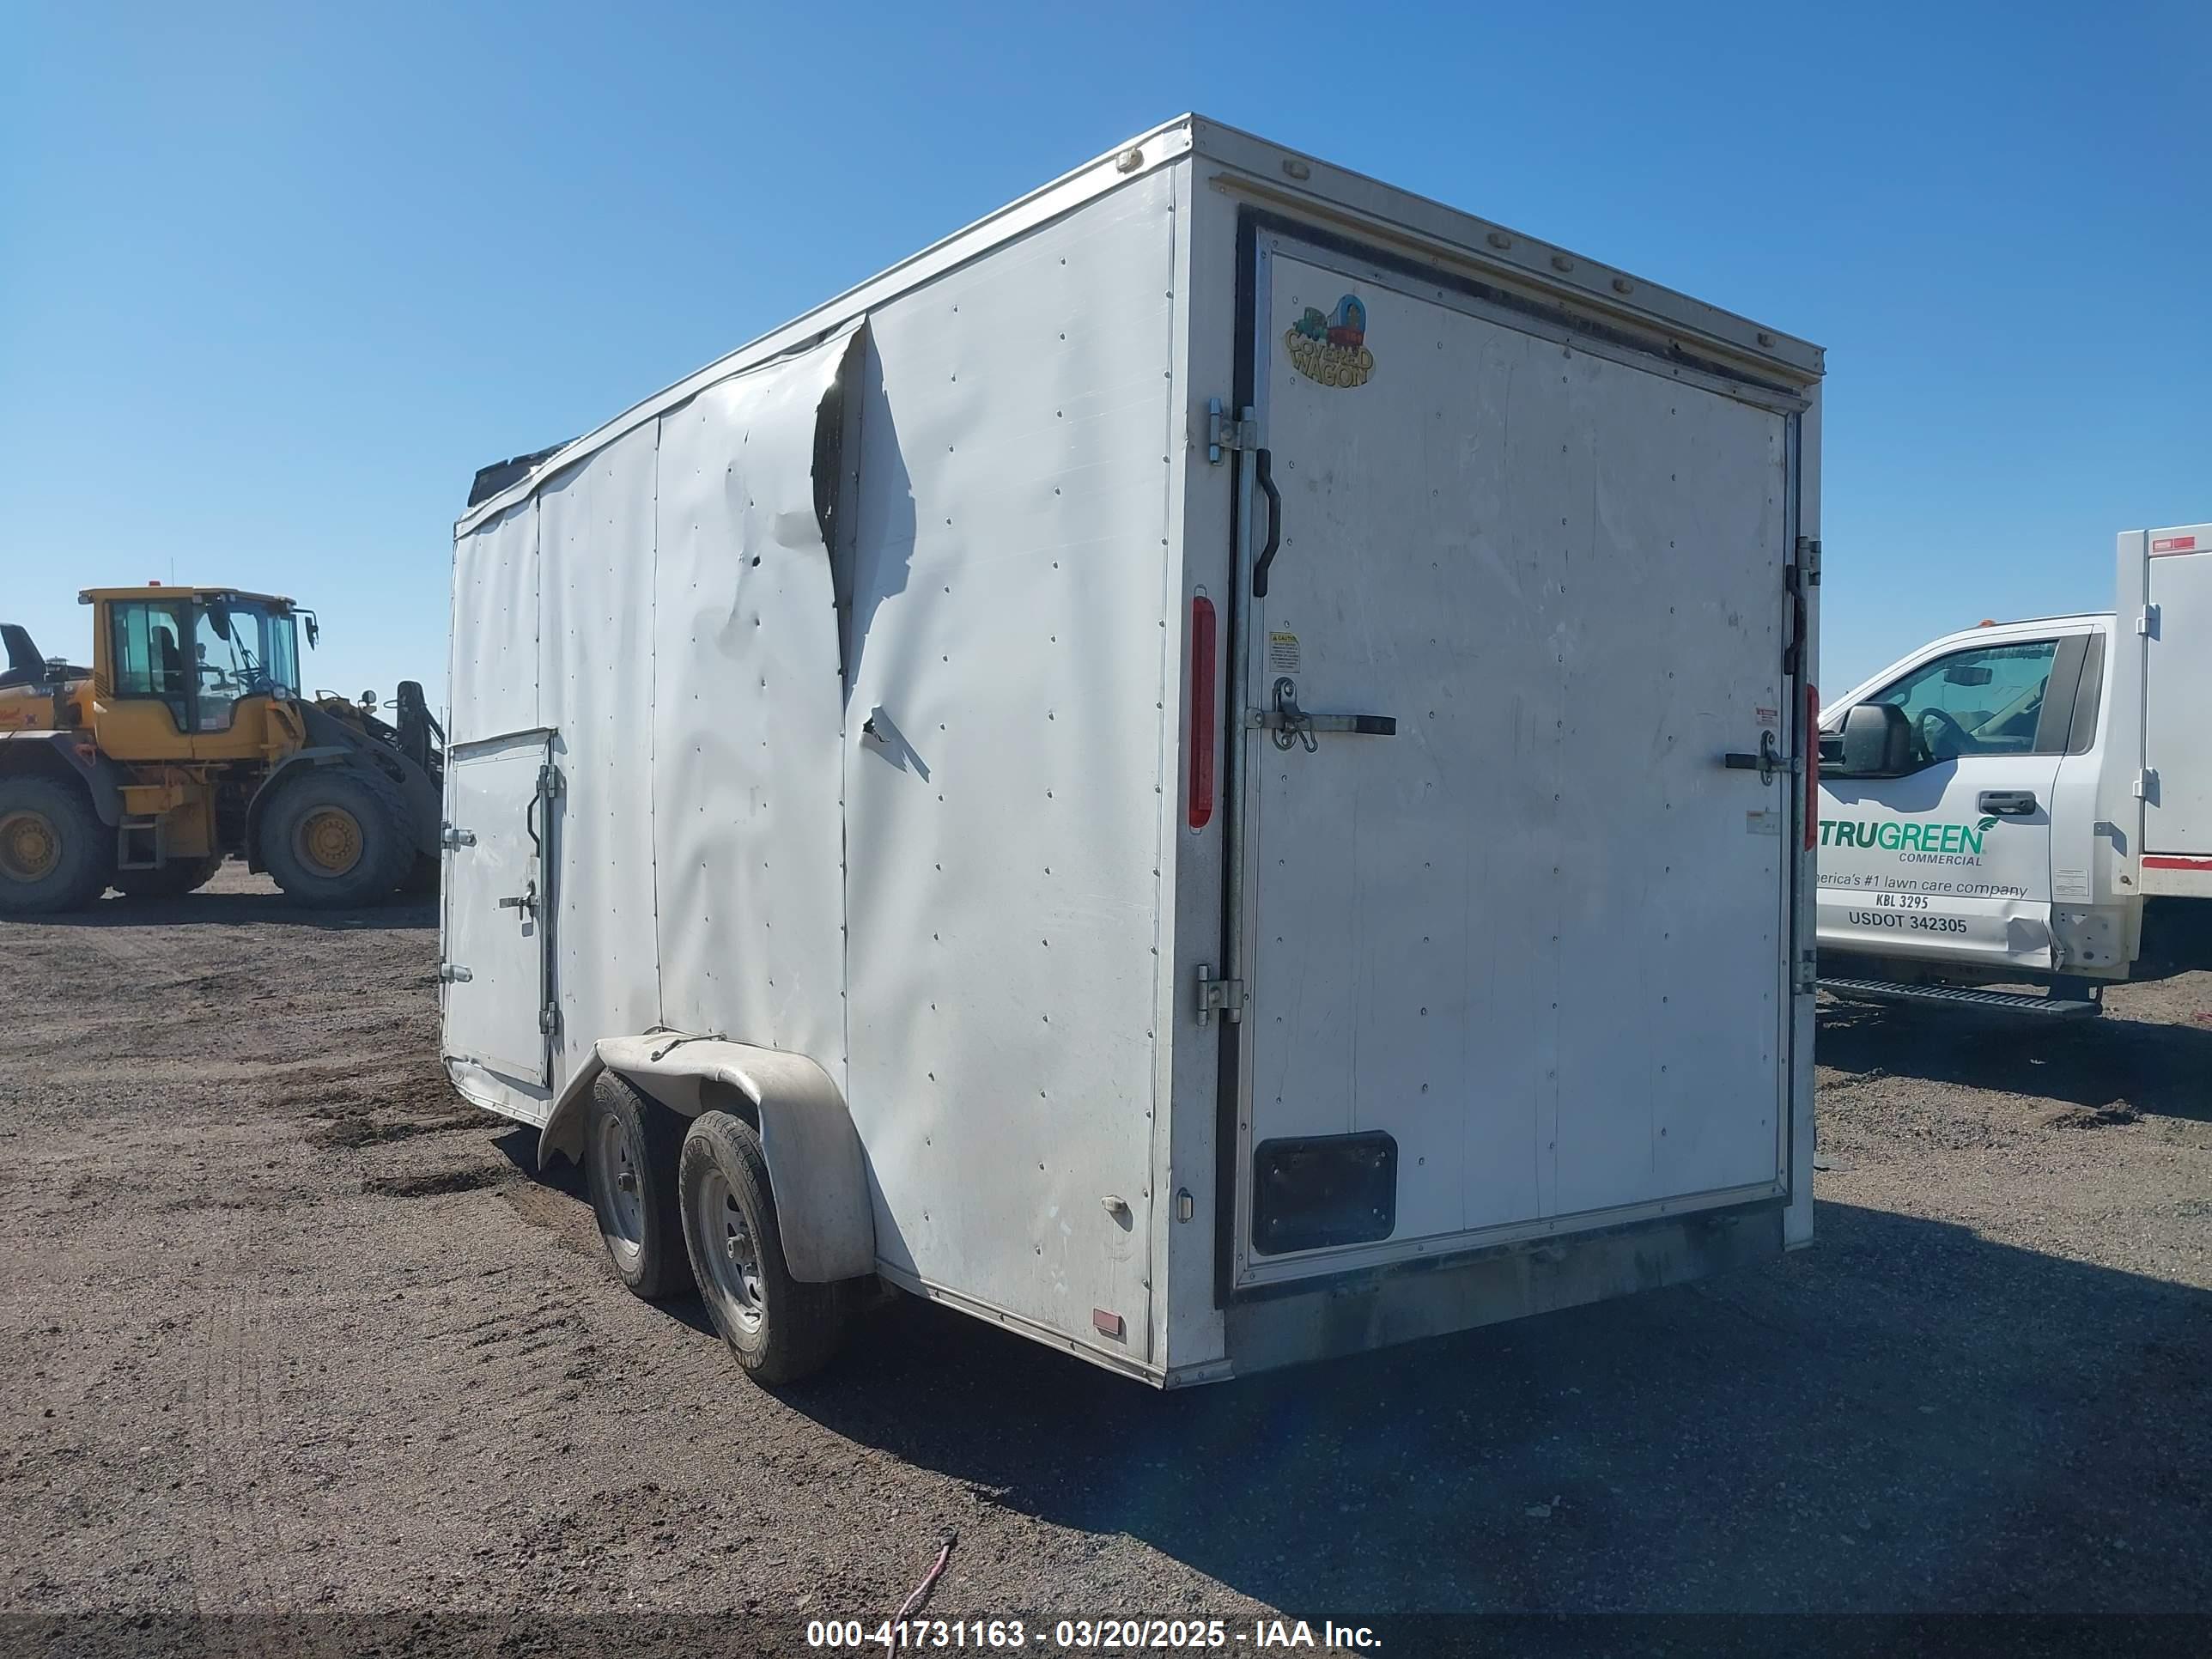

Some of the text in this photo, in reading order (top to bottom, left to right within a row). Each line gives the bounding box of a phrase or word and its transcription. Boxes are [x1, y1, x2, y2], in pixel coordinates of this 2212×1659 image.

[1285, 328, 1374, 369] COVERED
[1290, 350, 1369, 388] WAGON
[1819, 820, 1984, 854] TRUGREEN
[1899, 853, 1983, 866] COMMERCIAL
[1864, 874, 1880, 887] #1
[1884, 876, 1917, 890] lawn
[1921, 881, 1952, 893] care
[1956, 883, 2028, 899] company
[1876, 894, 1929, 909] KBL 3295
[1849, 911, 1967, 933] USDOT 342305
